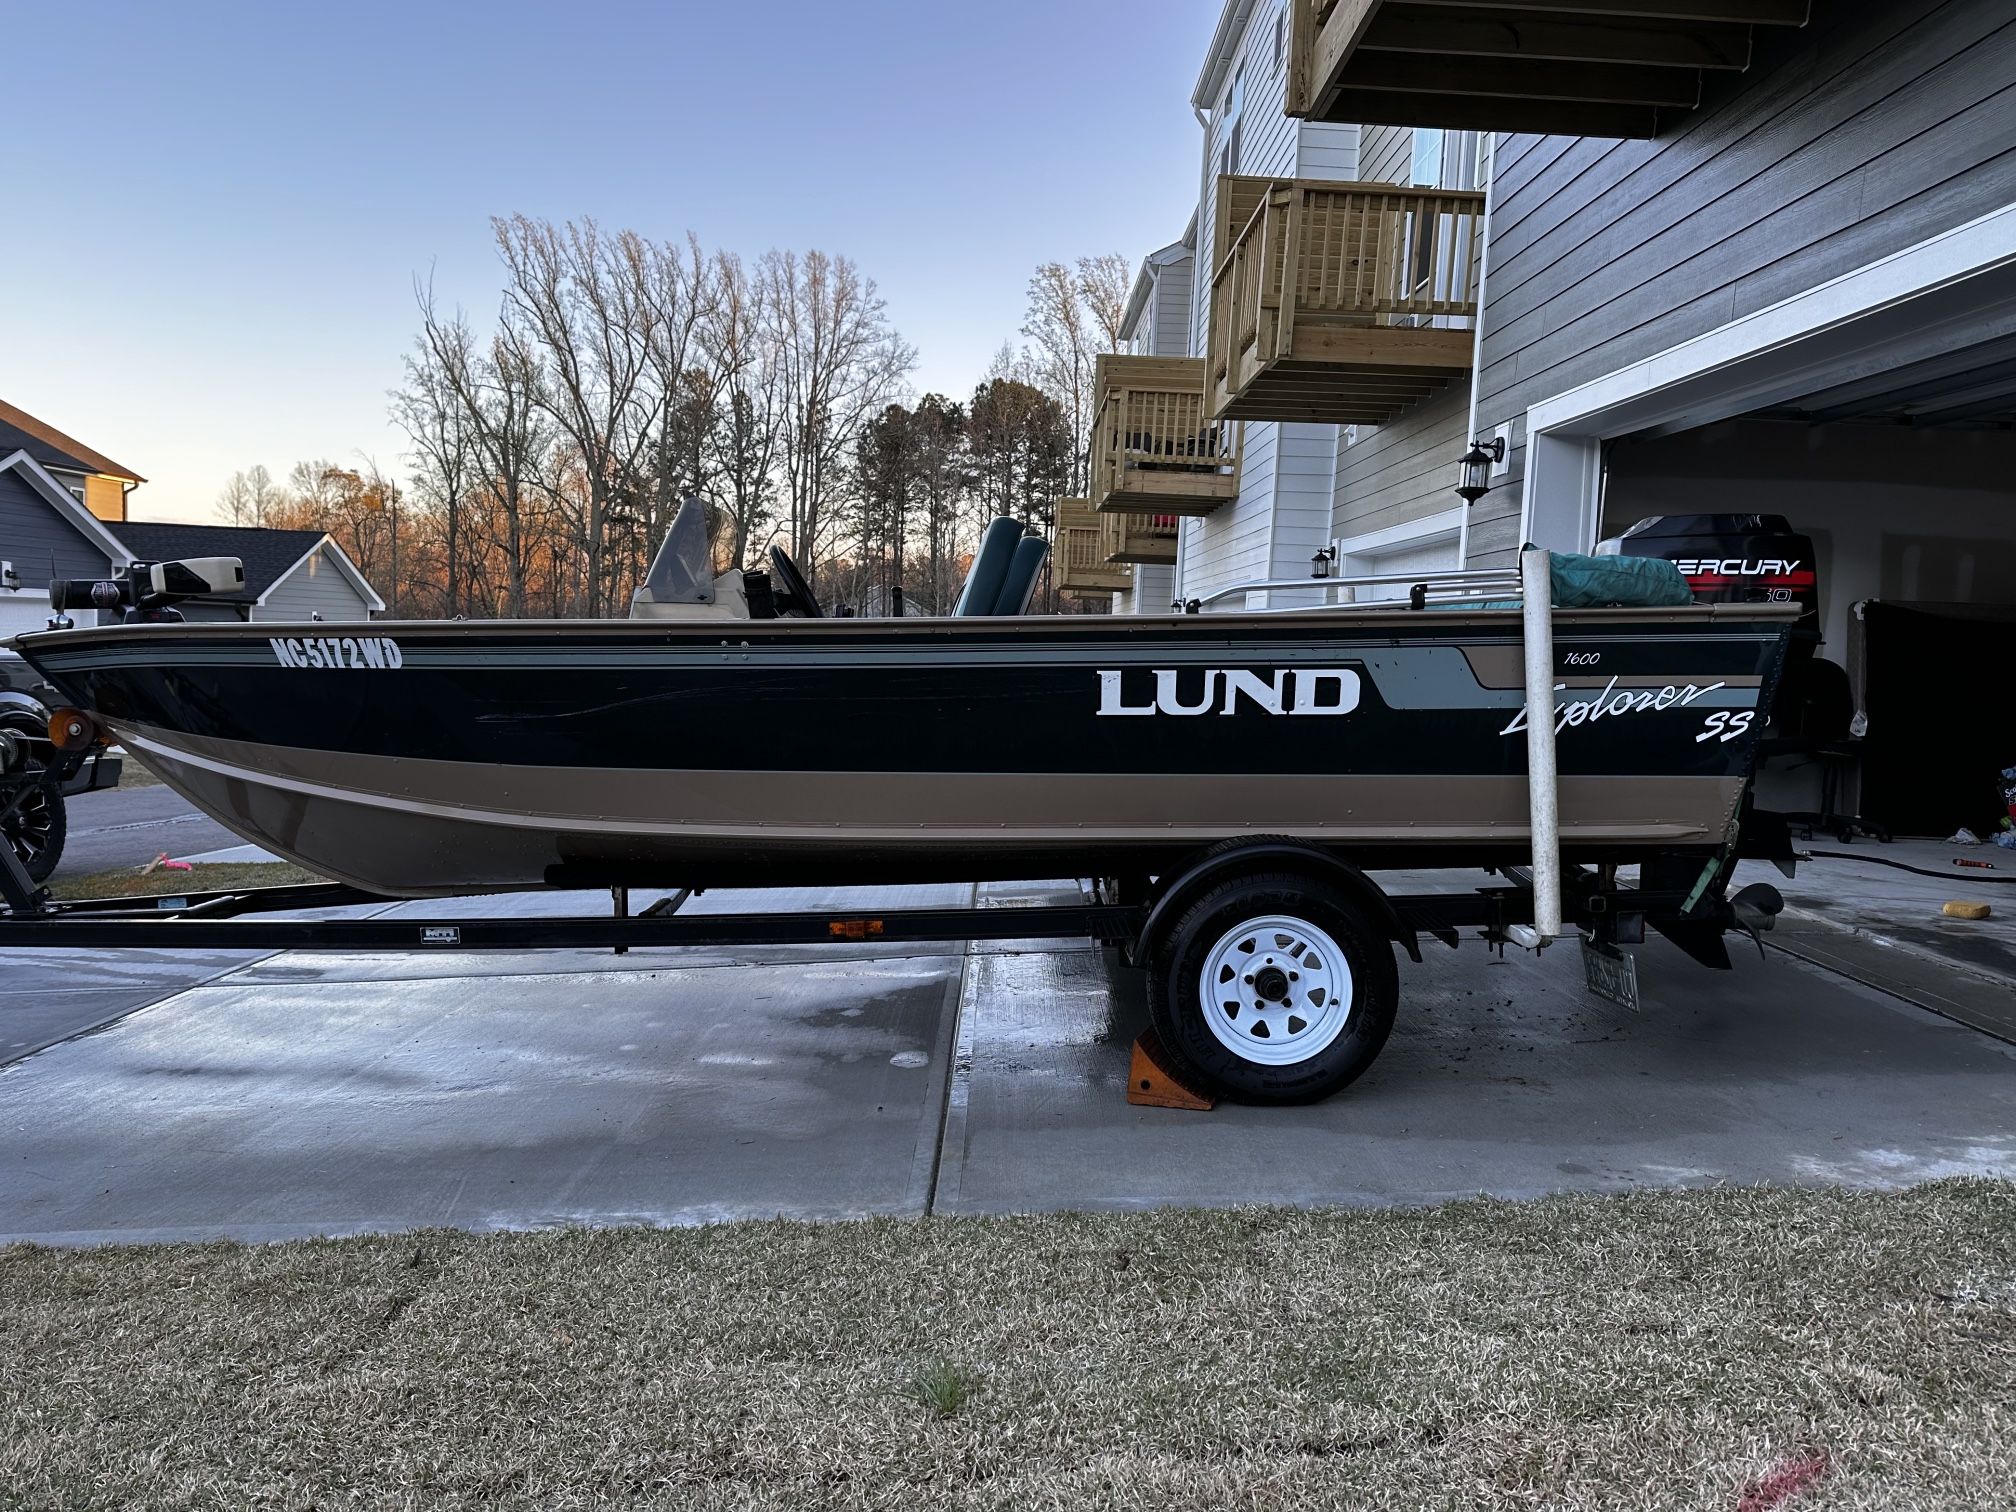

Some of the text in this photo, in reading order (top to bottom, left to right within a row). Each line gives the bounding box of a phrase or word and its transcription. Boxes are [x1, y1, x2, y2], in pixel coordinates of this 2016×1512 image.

[1670, 559, 1801, 575] ERCURY
[269, 637, 403, 669] NC5172WD
[1564, 652, 1600, 665] 1600
[1096, 669, 1360, 716] LUND
[1499, 675, 1725, 736] Eplorer
[1695, 711, 1755, 743] SS
